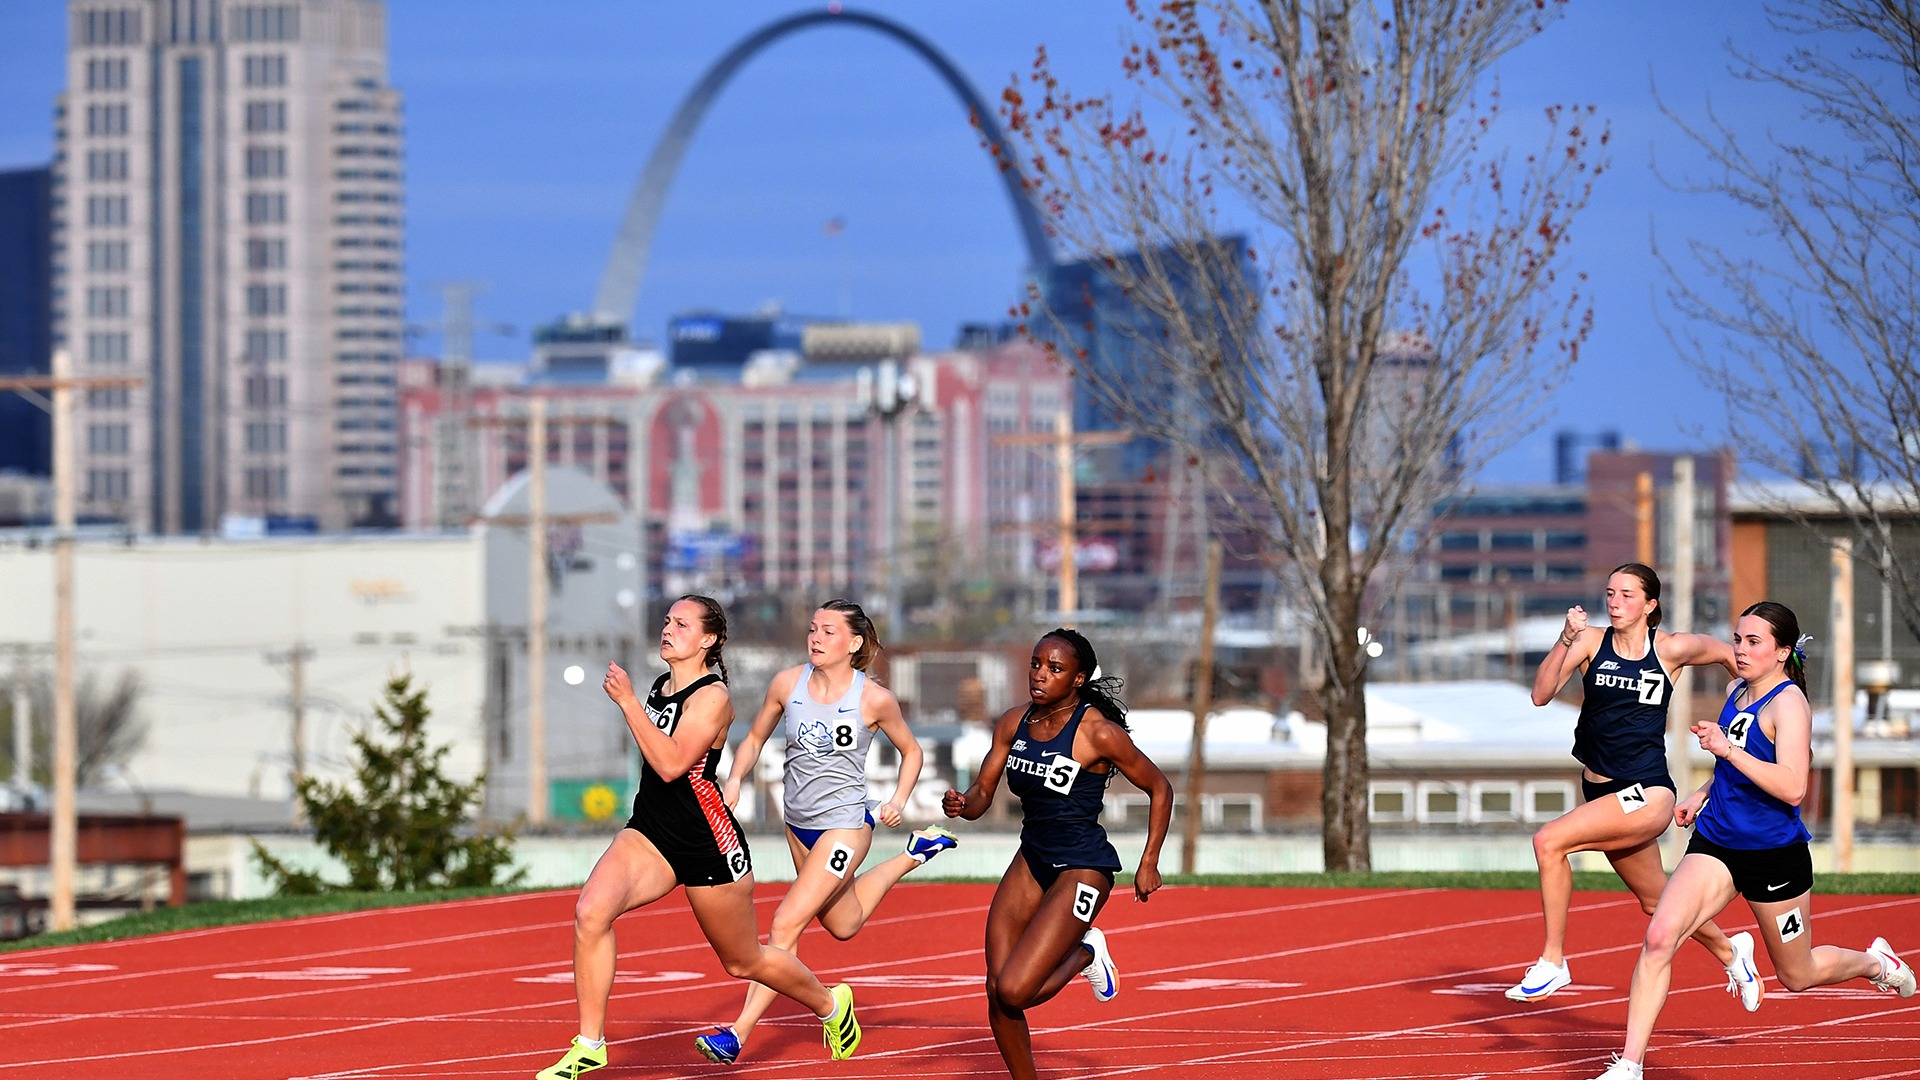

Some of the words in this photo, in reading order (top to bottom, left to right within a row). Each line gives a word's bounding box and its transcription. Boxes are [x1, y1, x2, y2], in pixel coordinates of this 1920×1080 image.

[1644, 679, 1661, 700] 7
[657, 707, 673, 729] 6
[1730, 718, 1747, 740] 4
[835, 725, 853, 747] 8
[1050, 765, 1073, 787] 5
[1623, 787, 1645, 803] 7
[731, 853, 746, 874] 6
[830, 849, 848, 872] 8
[1077, 891, 1093, 915] 5
[1782, 914, 1800, 935] 4
